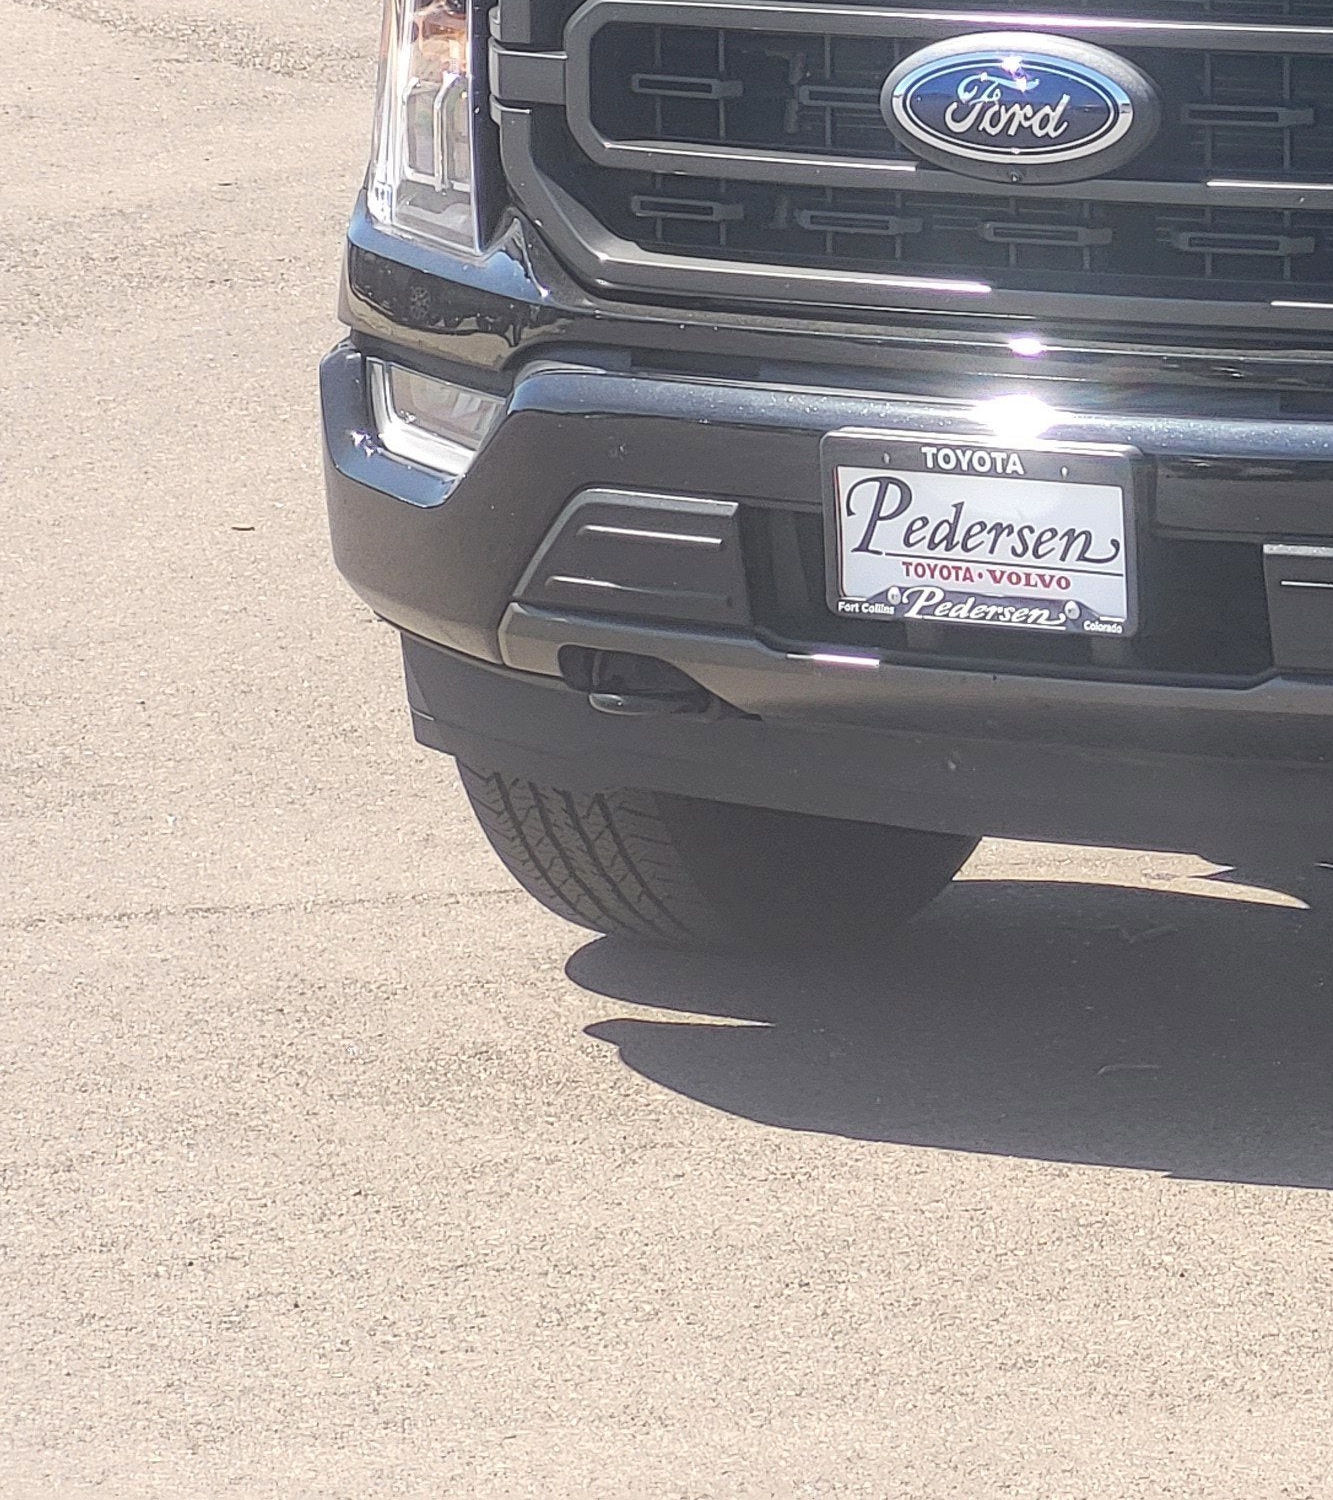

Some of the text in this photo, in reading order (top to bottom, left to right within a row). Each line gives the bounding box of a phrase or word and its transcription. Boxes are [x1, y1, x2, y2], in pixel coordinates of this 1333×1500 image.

[944, 69, 1072, 139] Ford
[921, 446, 1025, 475] TOYOTA
[846, 476, 1121, 564] Pedersen
[902, 561, 1072, 591] TOYOTA VOLVO
[837, 601, 895, 615] Fort Collins
[902, 586, 1067, 627] Pedersen
[1083, 620, 1123, 634] Colorado
